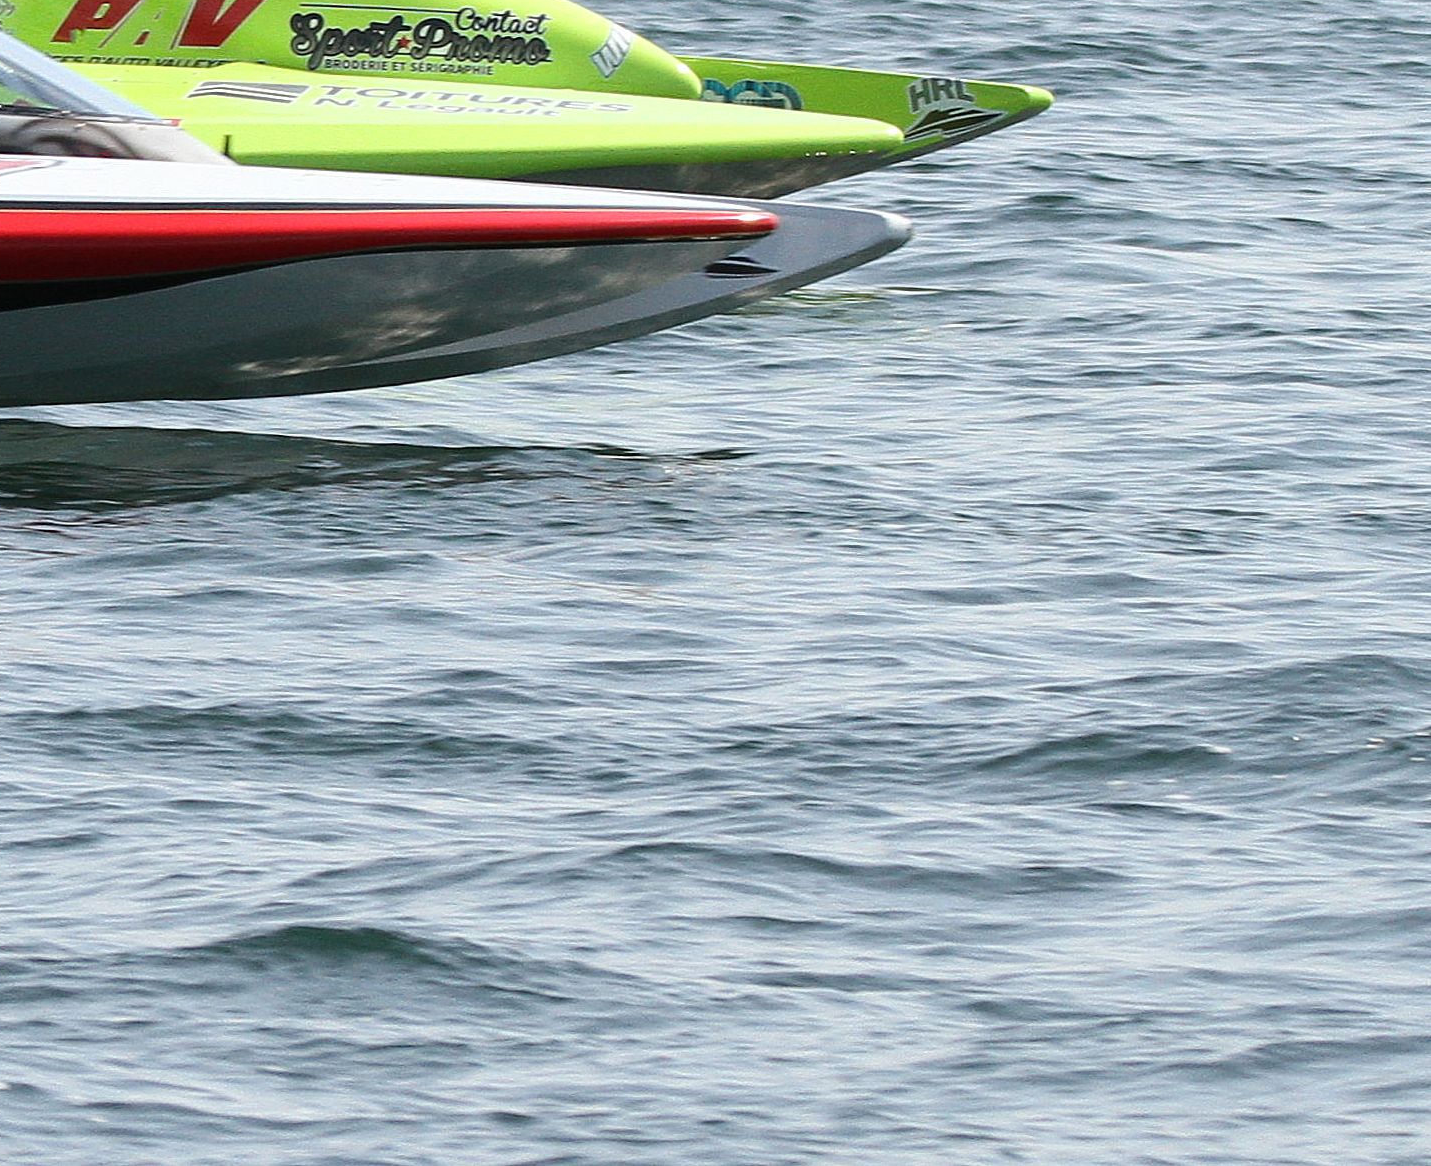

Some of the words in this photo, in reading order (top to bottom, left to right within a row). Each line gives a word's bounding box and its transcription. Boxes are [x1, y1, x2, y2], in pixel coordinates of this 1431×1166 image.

[455, 7, 550, 35] Contact
[290, 13, 410, 70] Sport
[411, 17, 552, 66] Promo
[324, 59, 388, 72] BRODERIE
[392, 62, 407, 73] ET
[320, 84, 634, 112] TOITURES
[376, 100, 562, 118] Legault
[907, 77, 975, 113] HRL
